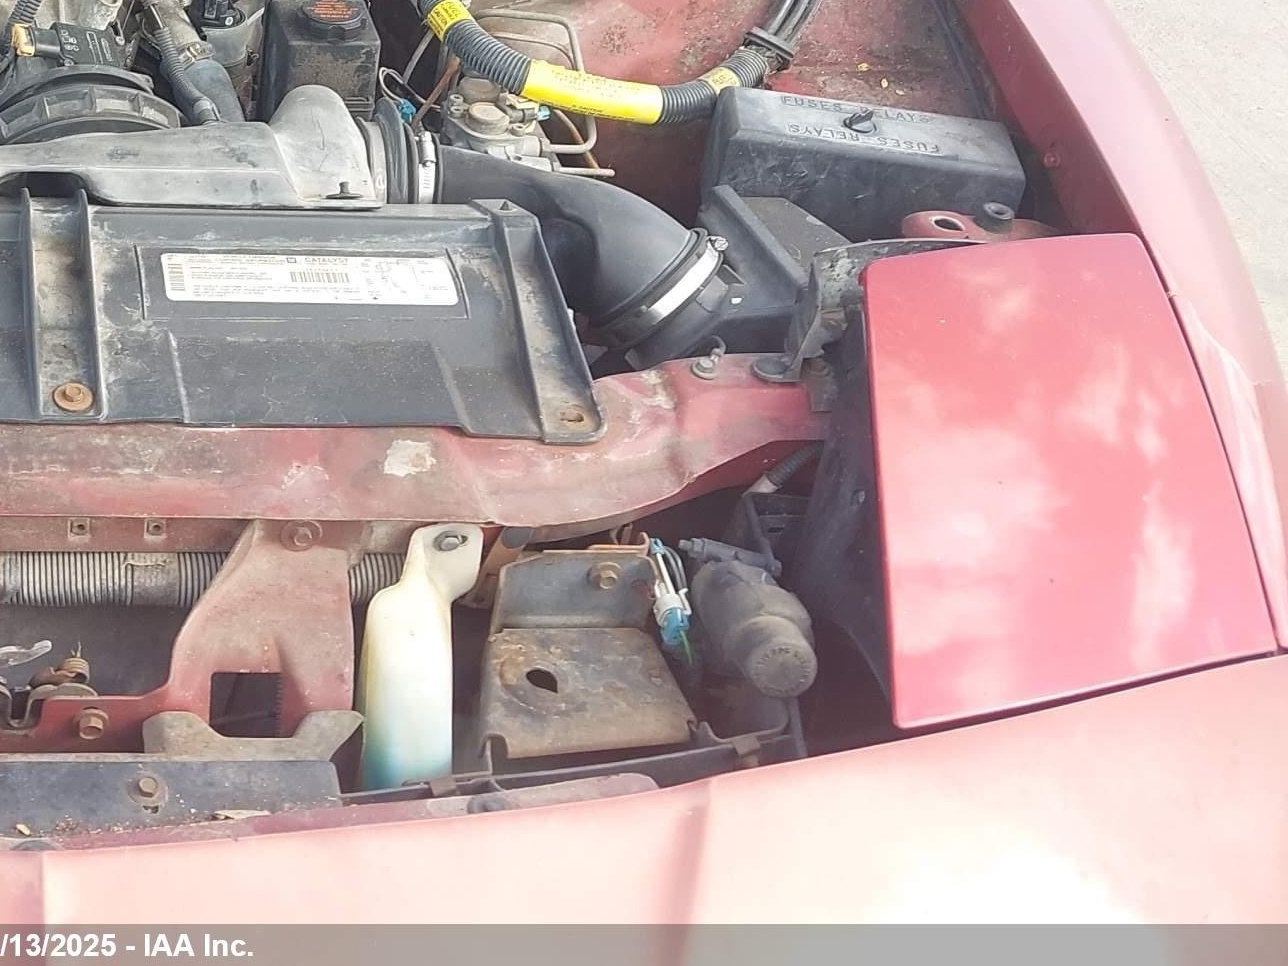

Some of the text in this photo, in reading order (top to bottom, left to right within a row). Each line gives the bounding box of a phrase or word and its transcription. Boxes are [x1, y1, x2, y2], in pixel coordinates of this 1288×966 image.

[780, 95, 843, 114] FUSES
[787, 122, 943, 155] FUSES RELAYS
